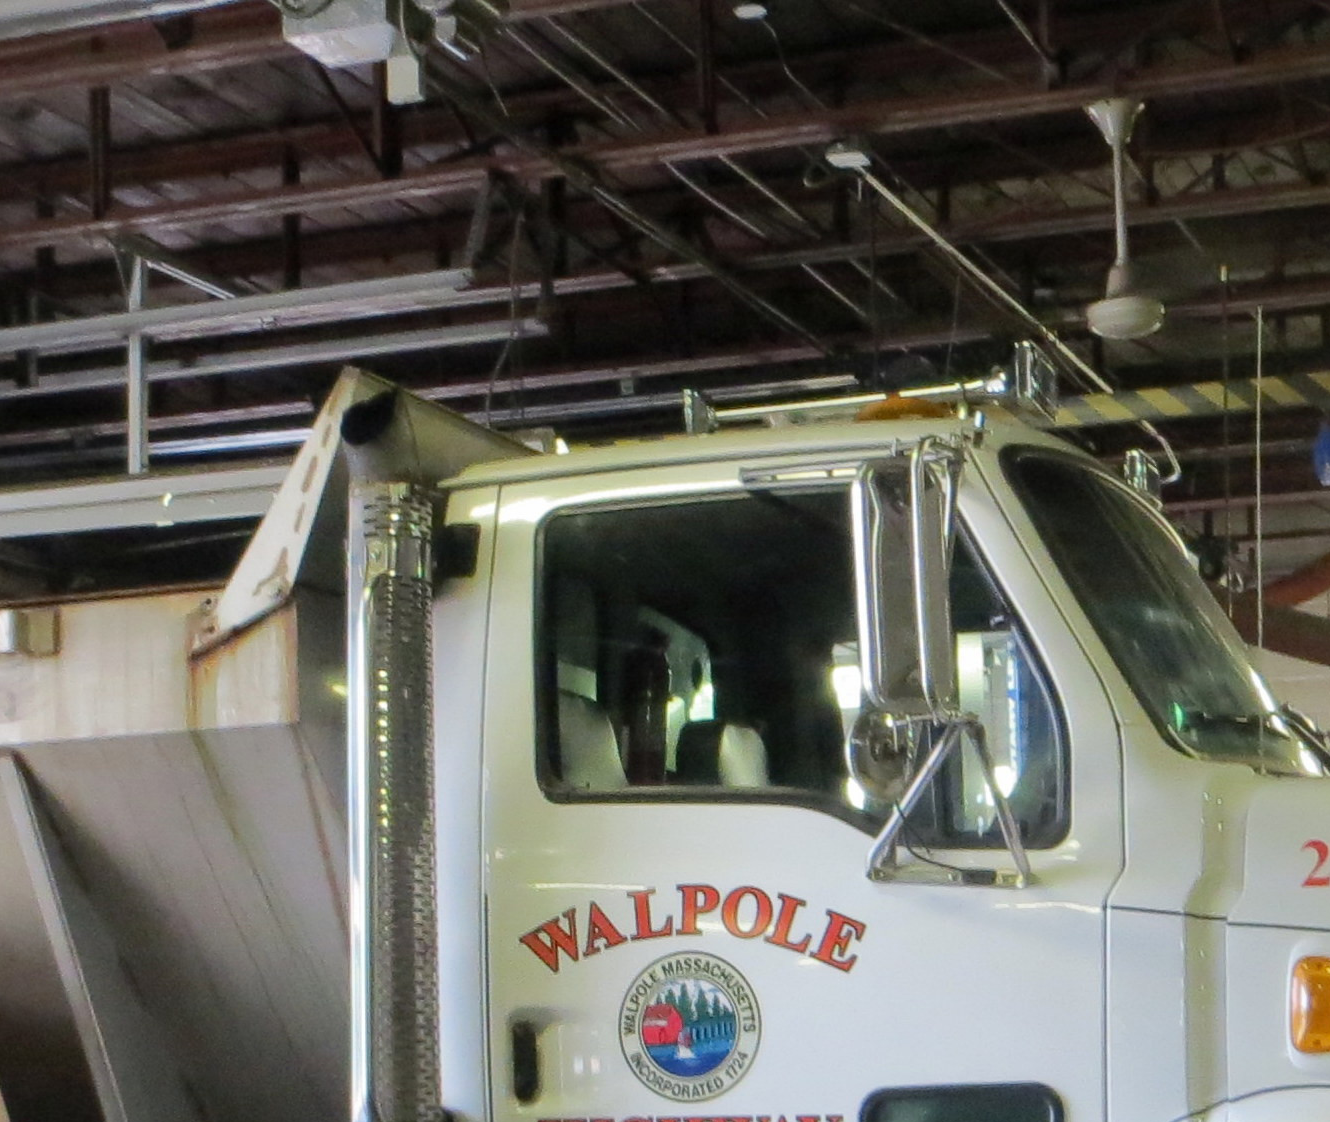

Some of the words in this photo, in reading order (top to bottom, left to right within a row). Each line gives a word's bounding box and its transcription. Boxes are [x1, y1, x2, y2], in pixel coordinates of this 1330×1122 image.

[519, 884, 867, 972] WALPOLE
[623, 970, 660, 1036] WALPOLE
[662, 957, 757, 1033] MASSACHUSETTS
[630, 1051, 724, 1098] INCORPORATED
[725, 1051, 749, 1080] 1724
